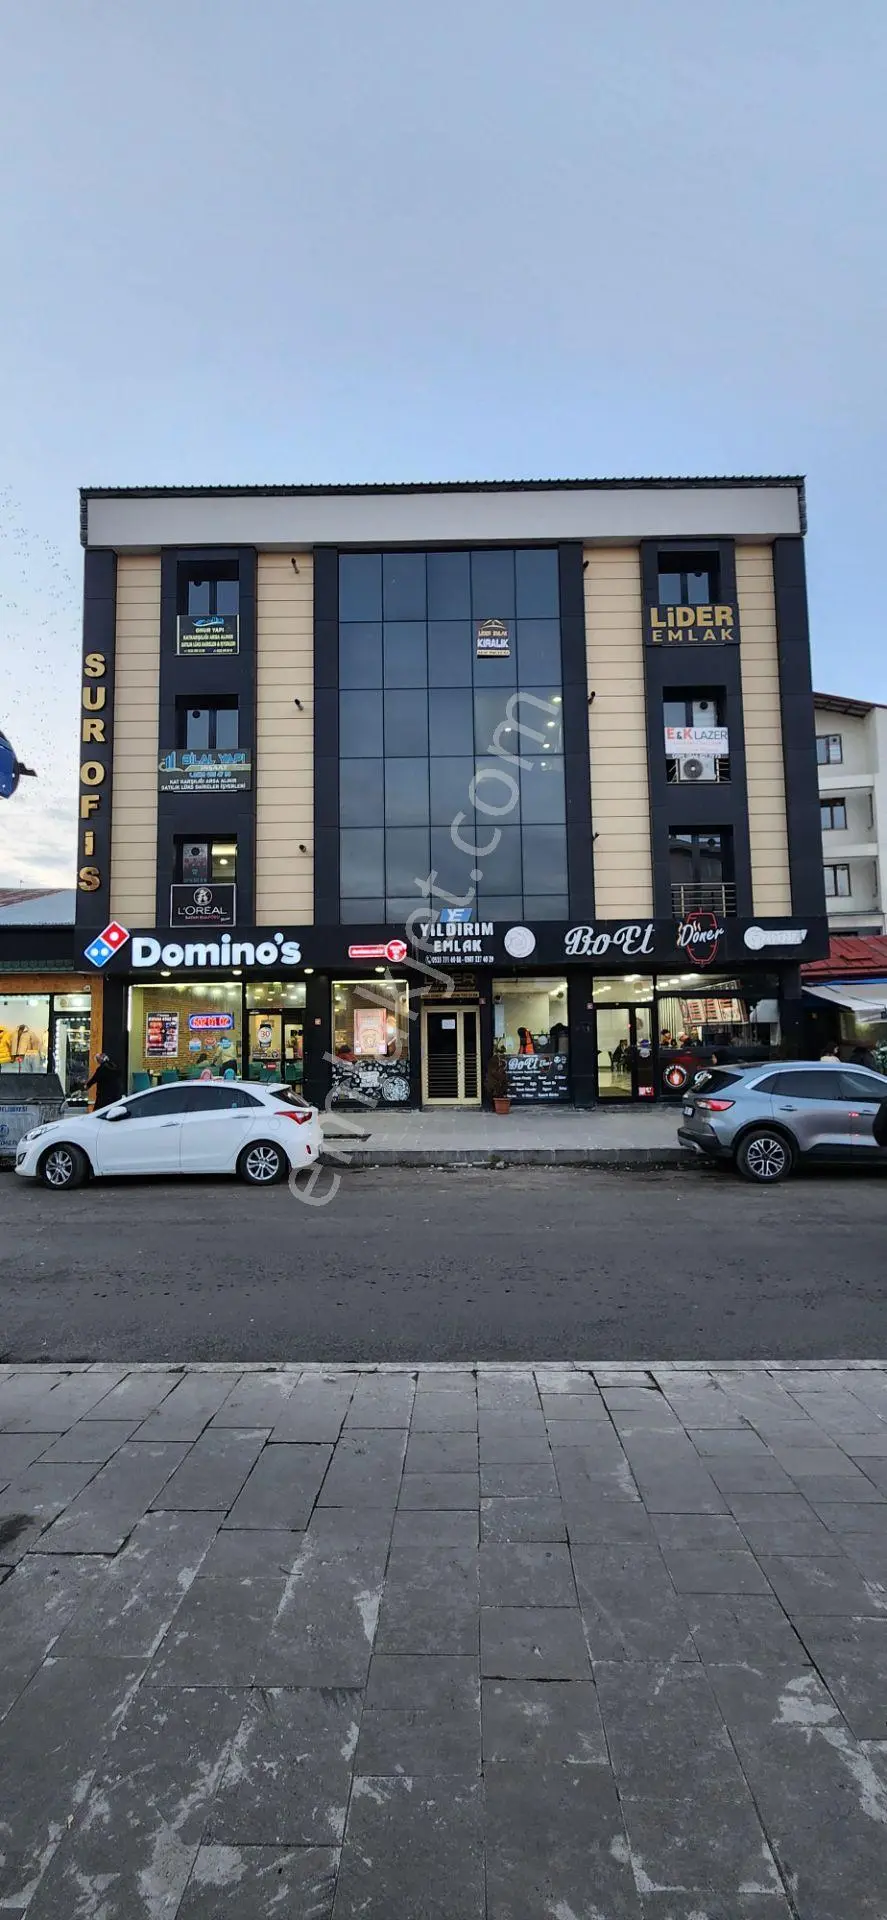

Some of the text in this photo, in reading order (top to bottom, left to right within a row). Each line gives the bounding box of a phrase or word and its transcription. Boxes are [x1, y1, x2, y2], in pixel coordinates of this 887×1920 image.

[652, 629, 734, 641] EMLAK
[477, 638, 509, 648] KIRALIK
[83, 653, 106, 742] SUR
[694, 730, 728, 740] LAZER
[419, 922, 494, 937] YILDIRIM
[131, 932, 302, 967] Domino's
[433, 940, 482, 953] EMLAK
[260, 1030, 271, 1038] 30
